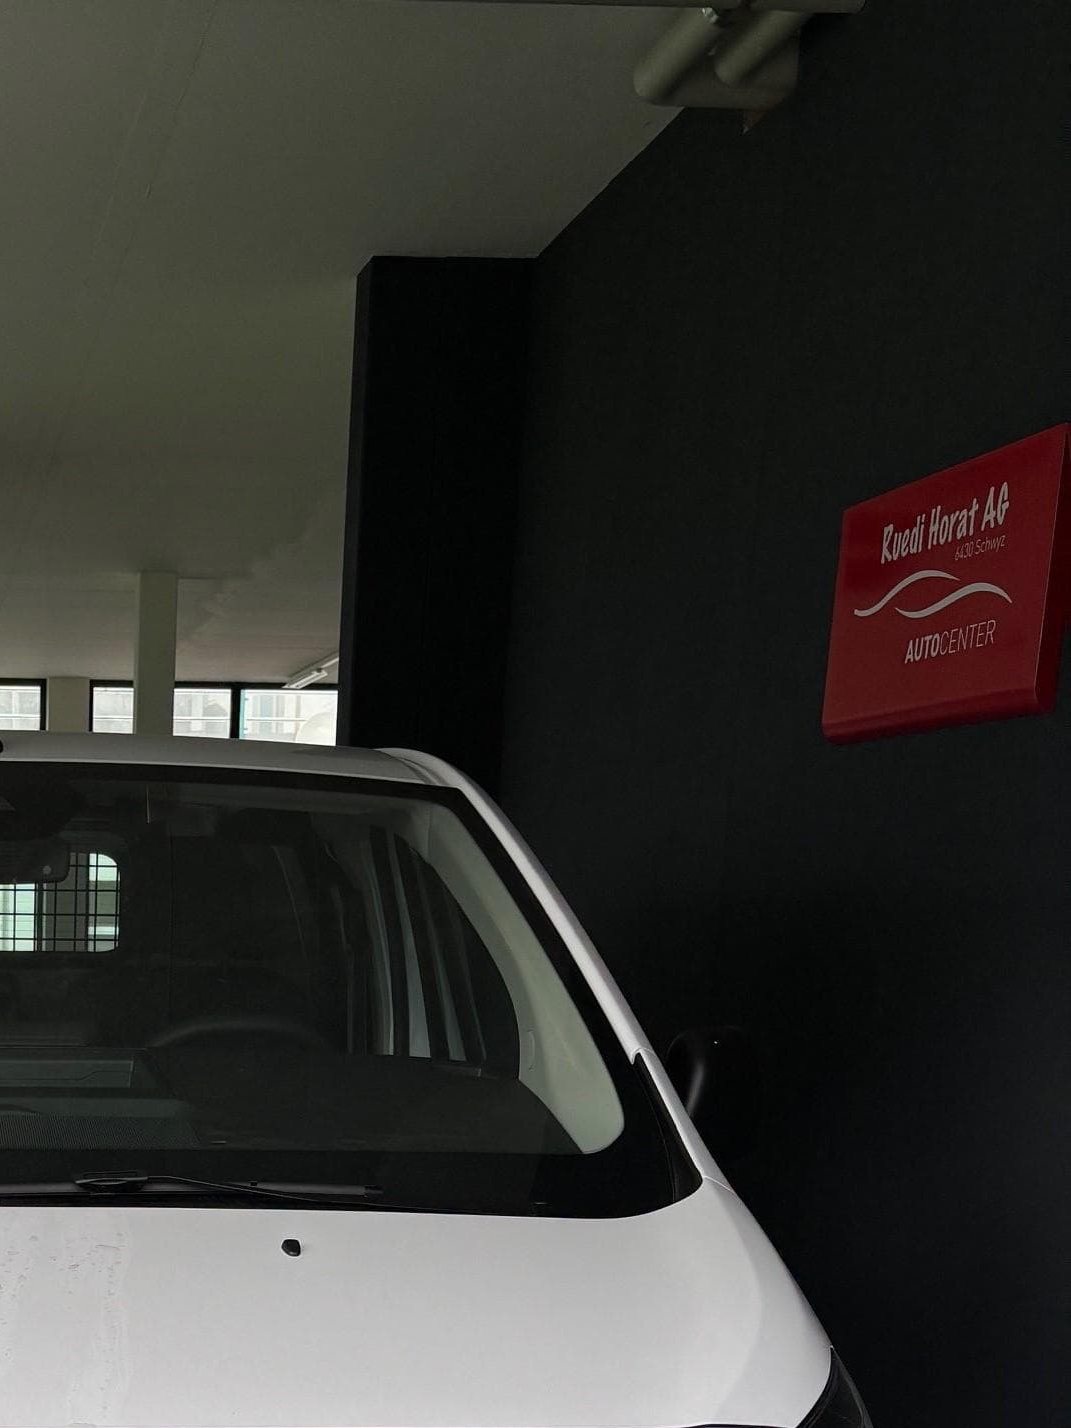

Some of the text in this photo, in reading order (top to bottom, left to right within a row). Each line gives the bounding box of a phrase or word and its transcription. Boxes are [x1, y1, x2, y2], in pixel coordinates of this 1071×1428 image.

[881, 481, 1010, 565] Ruedi Horat AG
[954, 535, 1006, 561] 6430 Schwyz
[904, 619, 997, 664] AUTOCENTER
